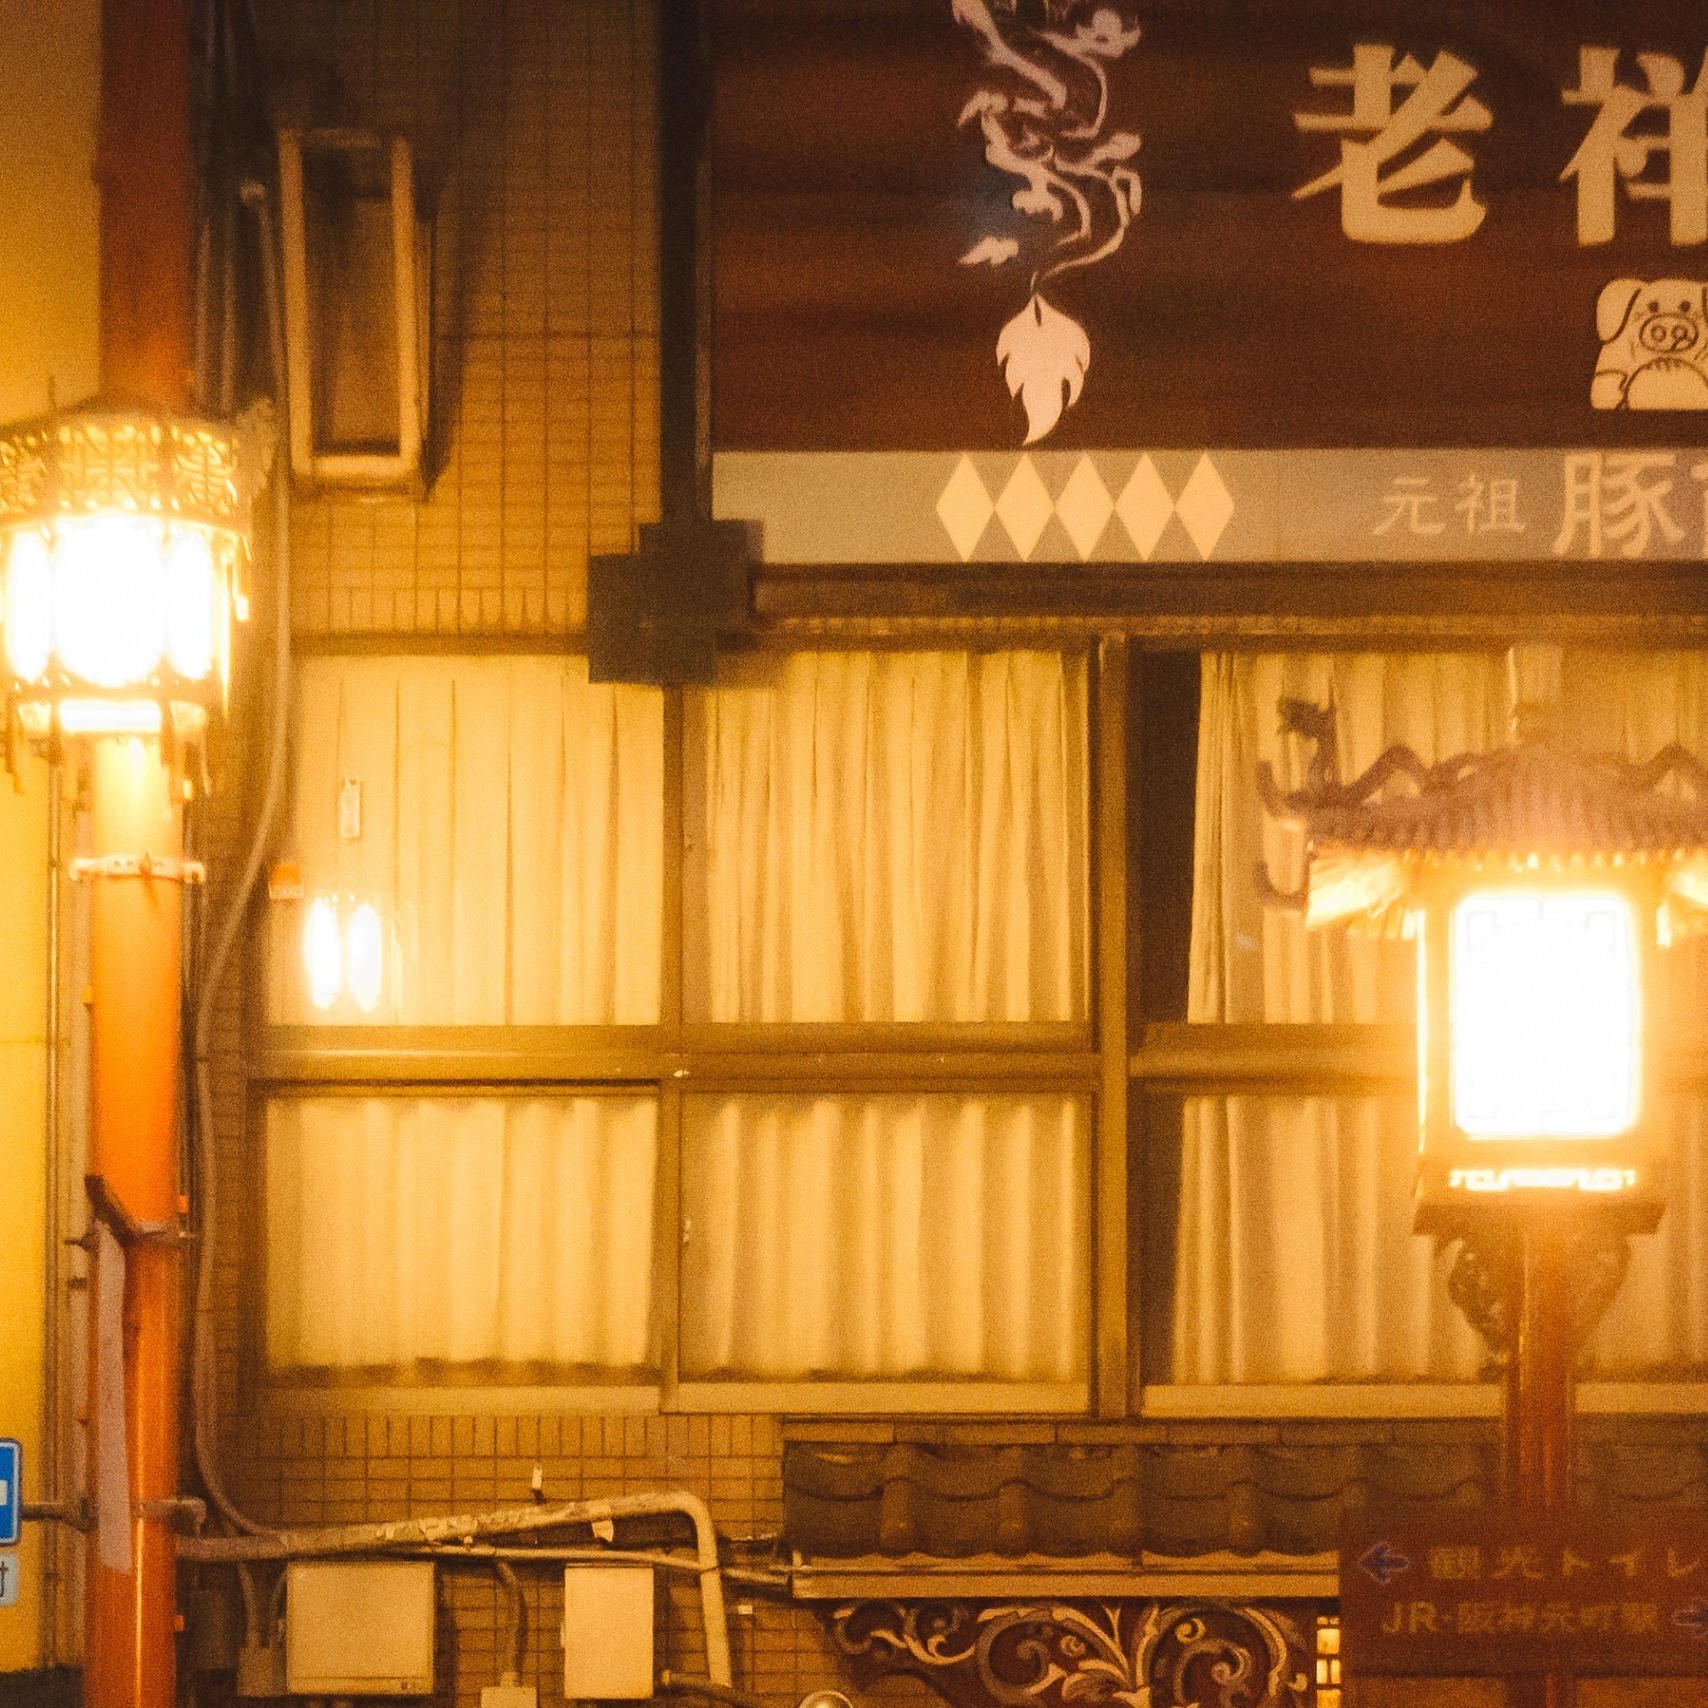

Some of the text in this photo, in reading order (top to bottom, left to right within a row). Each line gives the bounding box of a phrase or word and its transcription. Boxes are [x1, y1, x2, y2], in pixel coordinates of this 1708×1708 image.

[1373, 472, 1530, 540] 元祖
[1427, 1545, 1701, 1582] 観光トイレ
